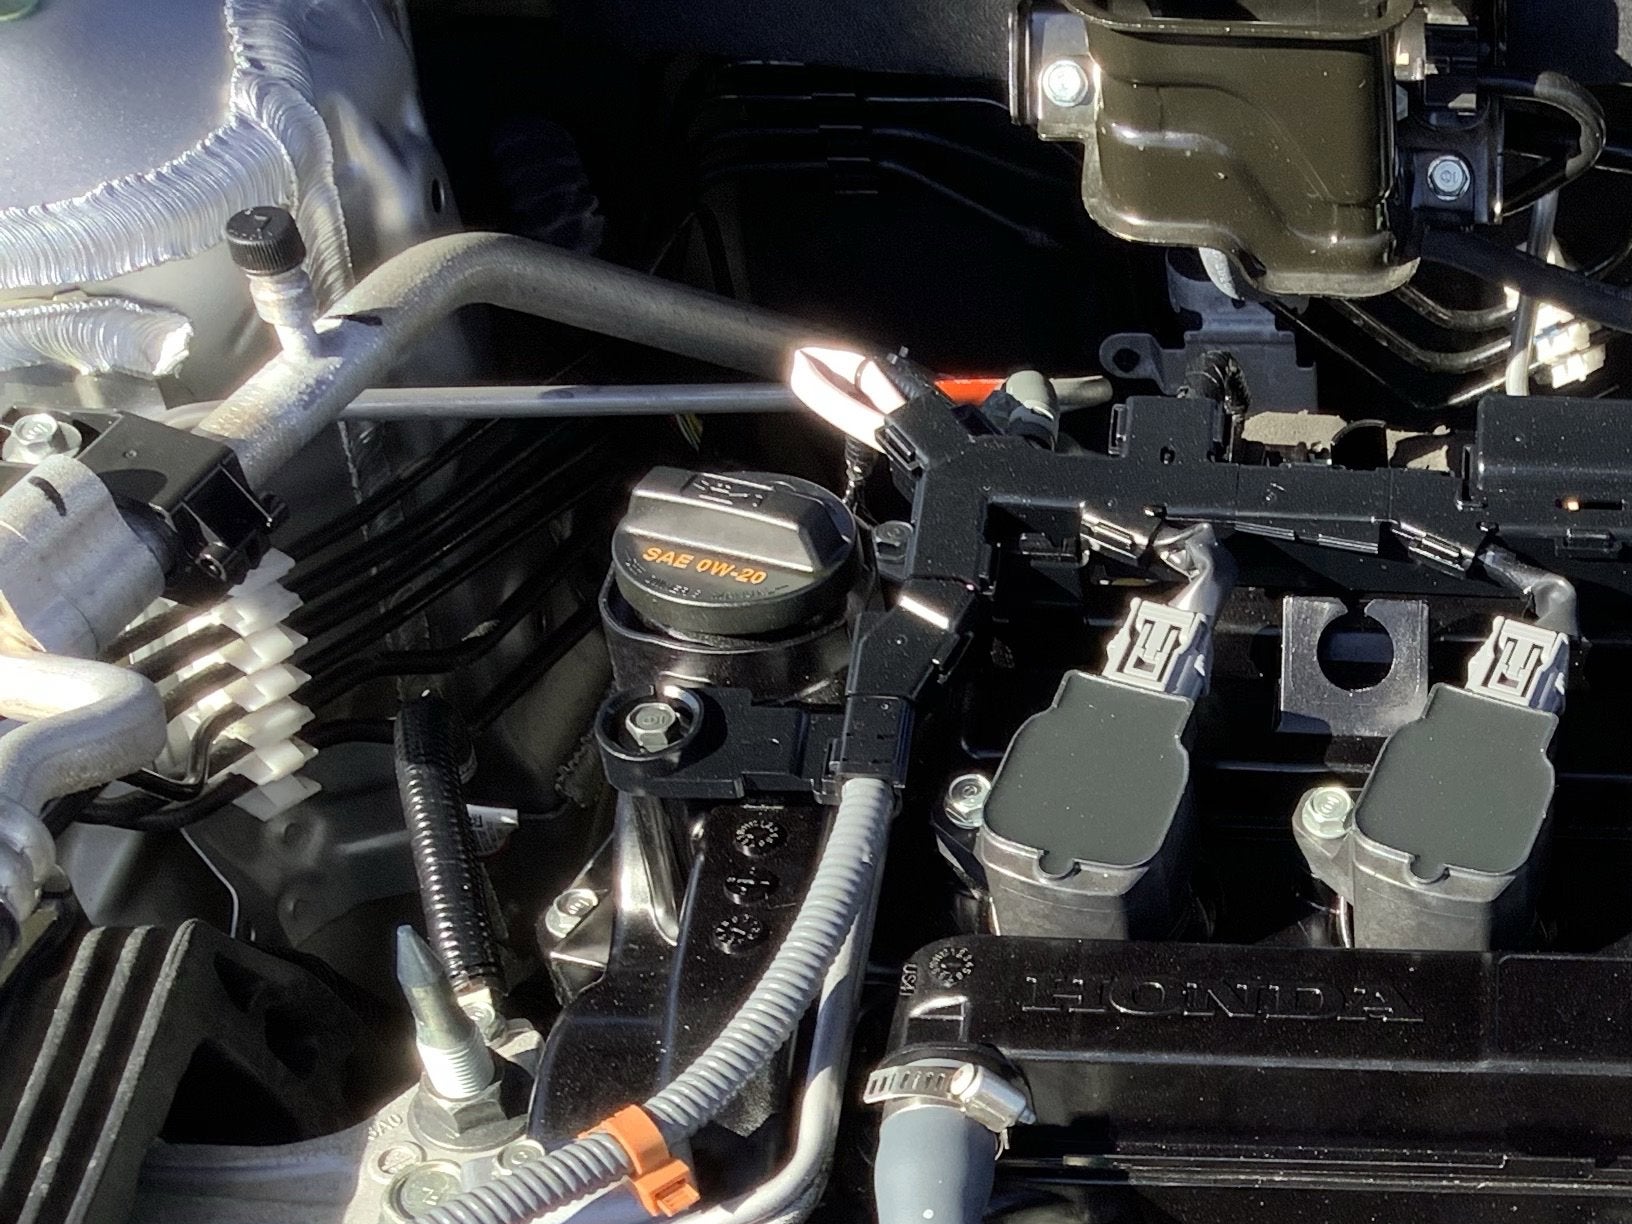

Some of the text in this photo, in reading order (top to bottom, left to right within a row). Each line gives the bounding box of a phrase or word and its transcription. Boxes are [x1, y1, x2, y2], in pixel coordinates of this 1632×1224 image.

[642, 546, 695, 570] SAE
[695, 557, 768, 586] 0W-20
[899, 963, 918, 996] USA
[1021, 975, 1426, 1023] HONDA
